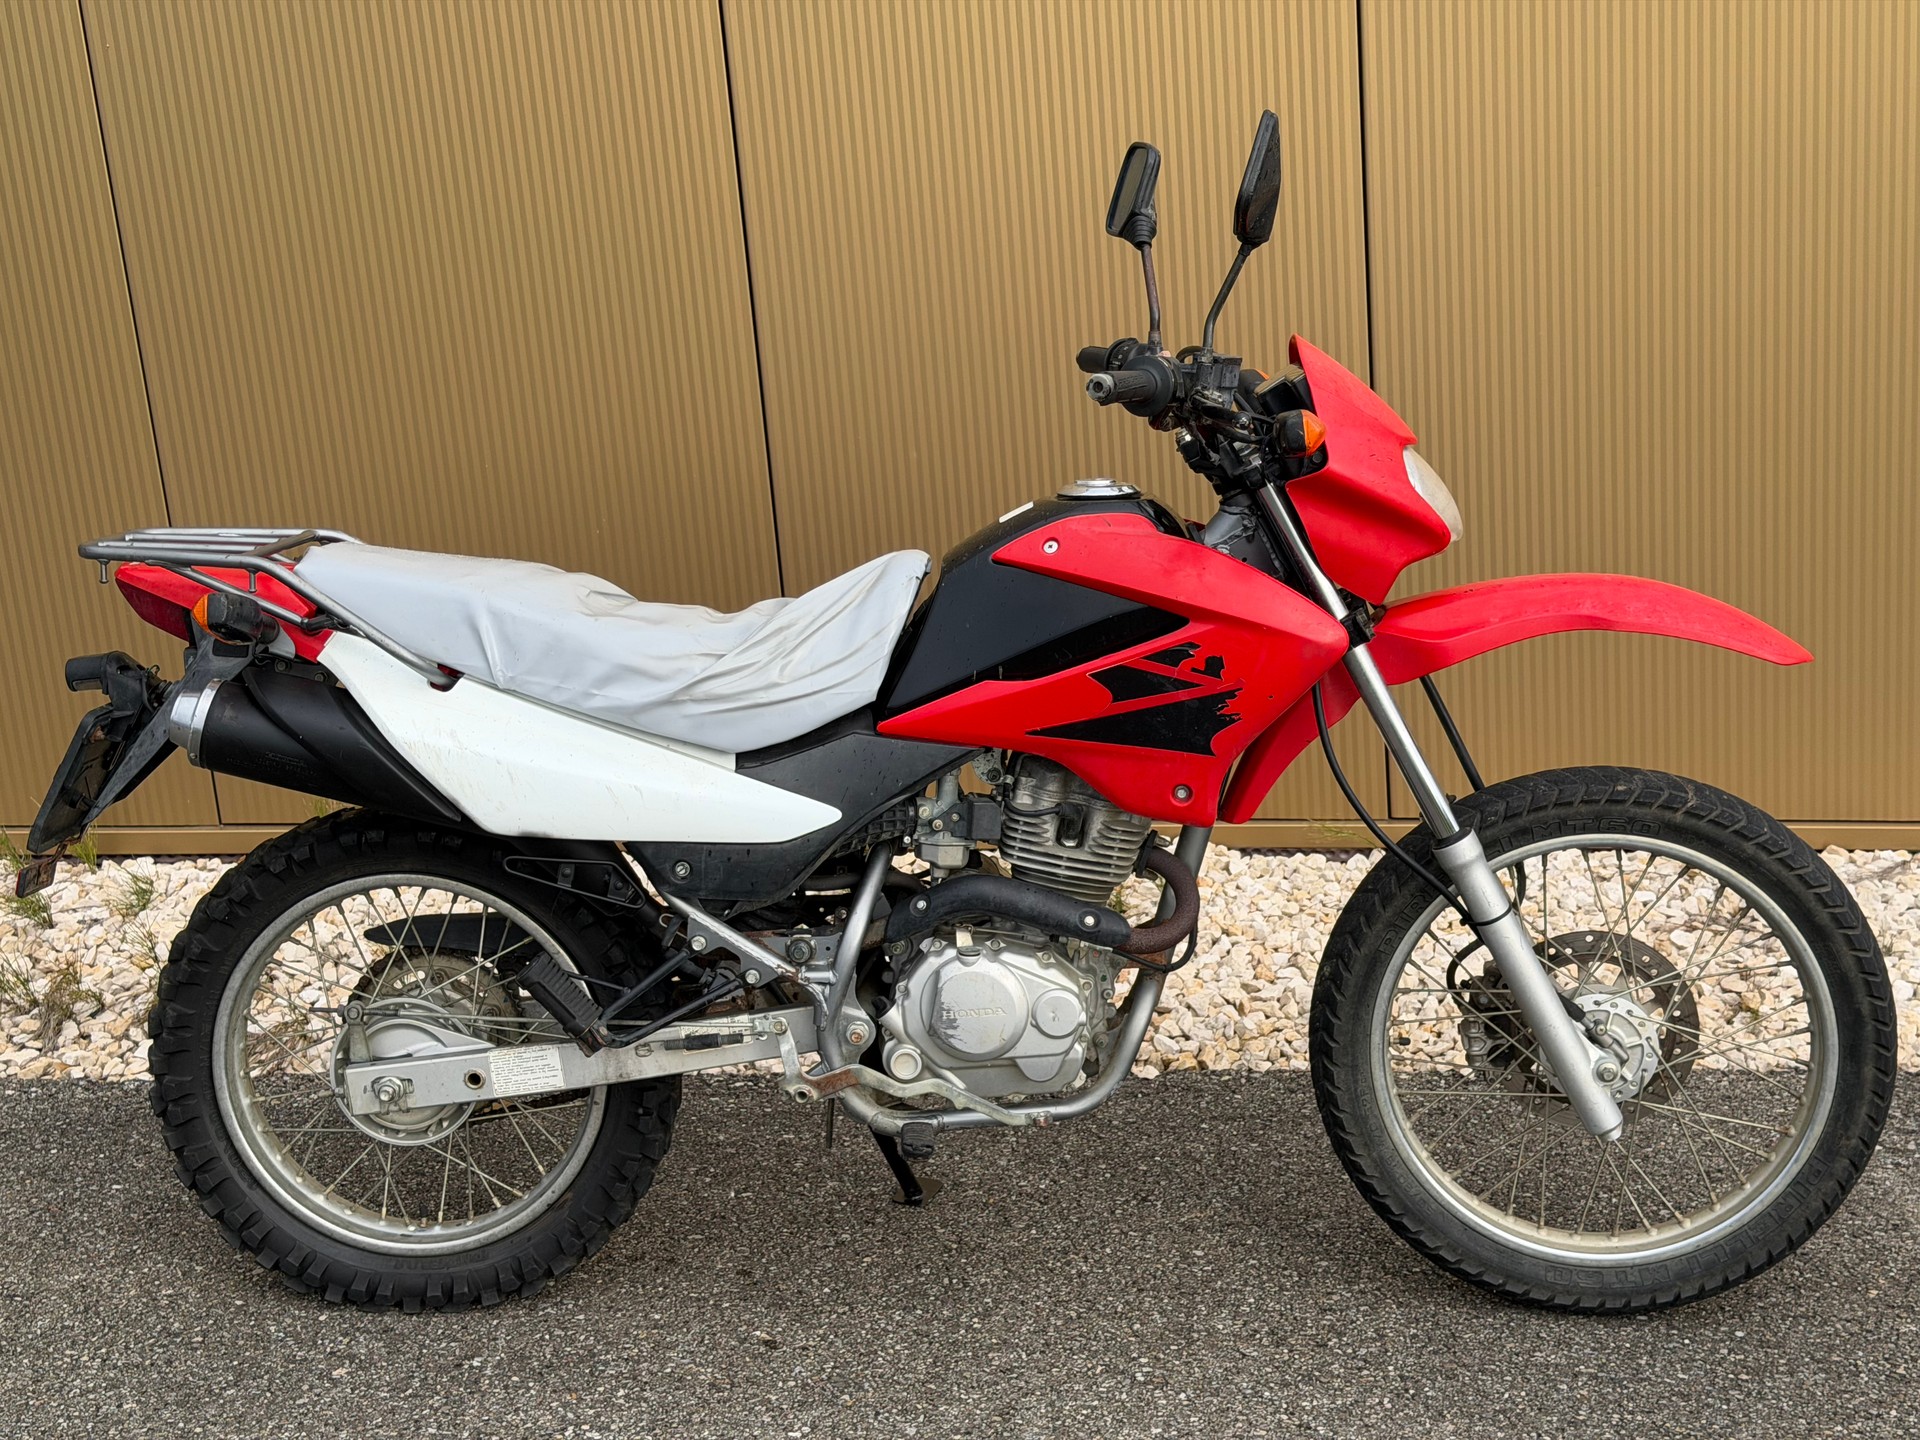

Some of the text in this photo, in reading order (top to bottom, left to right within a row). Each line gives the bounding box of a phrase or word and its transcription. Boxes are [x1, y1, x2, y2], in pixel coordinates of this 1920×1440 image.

[1531, 817, 1662, 842] MT60
[943, 1007, 1007, 1019] HONDA
[1543, 1154, 1829, 1290] PIRELLI MT60
